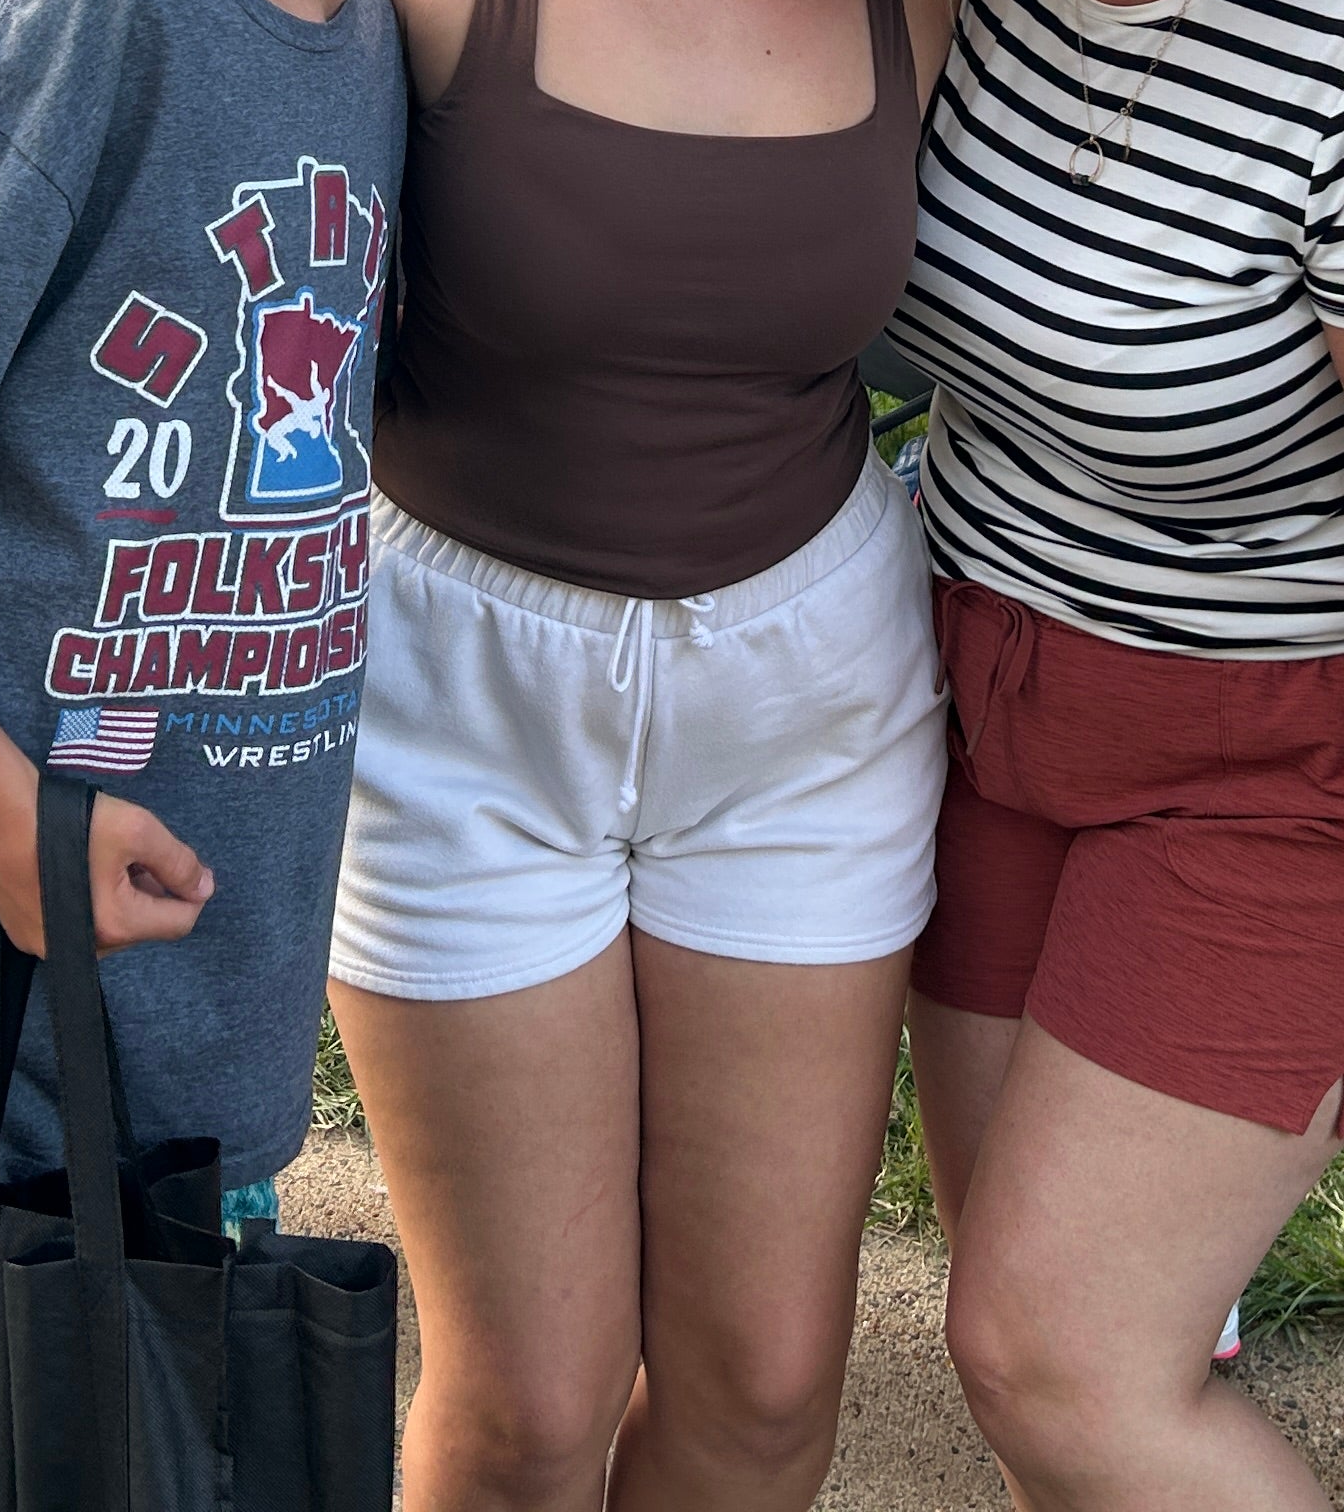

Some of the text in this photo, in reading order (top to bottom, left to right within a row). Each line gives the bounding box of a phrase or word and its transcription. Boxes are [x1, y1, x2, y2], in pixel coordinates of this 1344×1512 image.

[90, 162, 389, 409] STA
[101, 417, 192, 499] 20
[93, 508, 370, 628] FOLKSY
[165, 690, 357, 736] MINNESOTA
